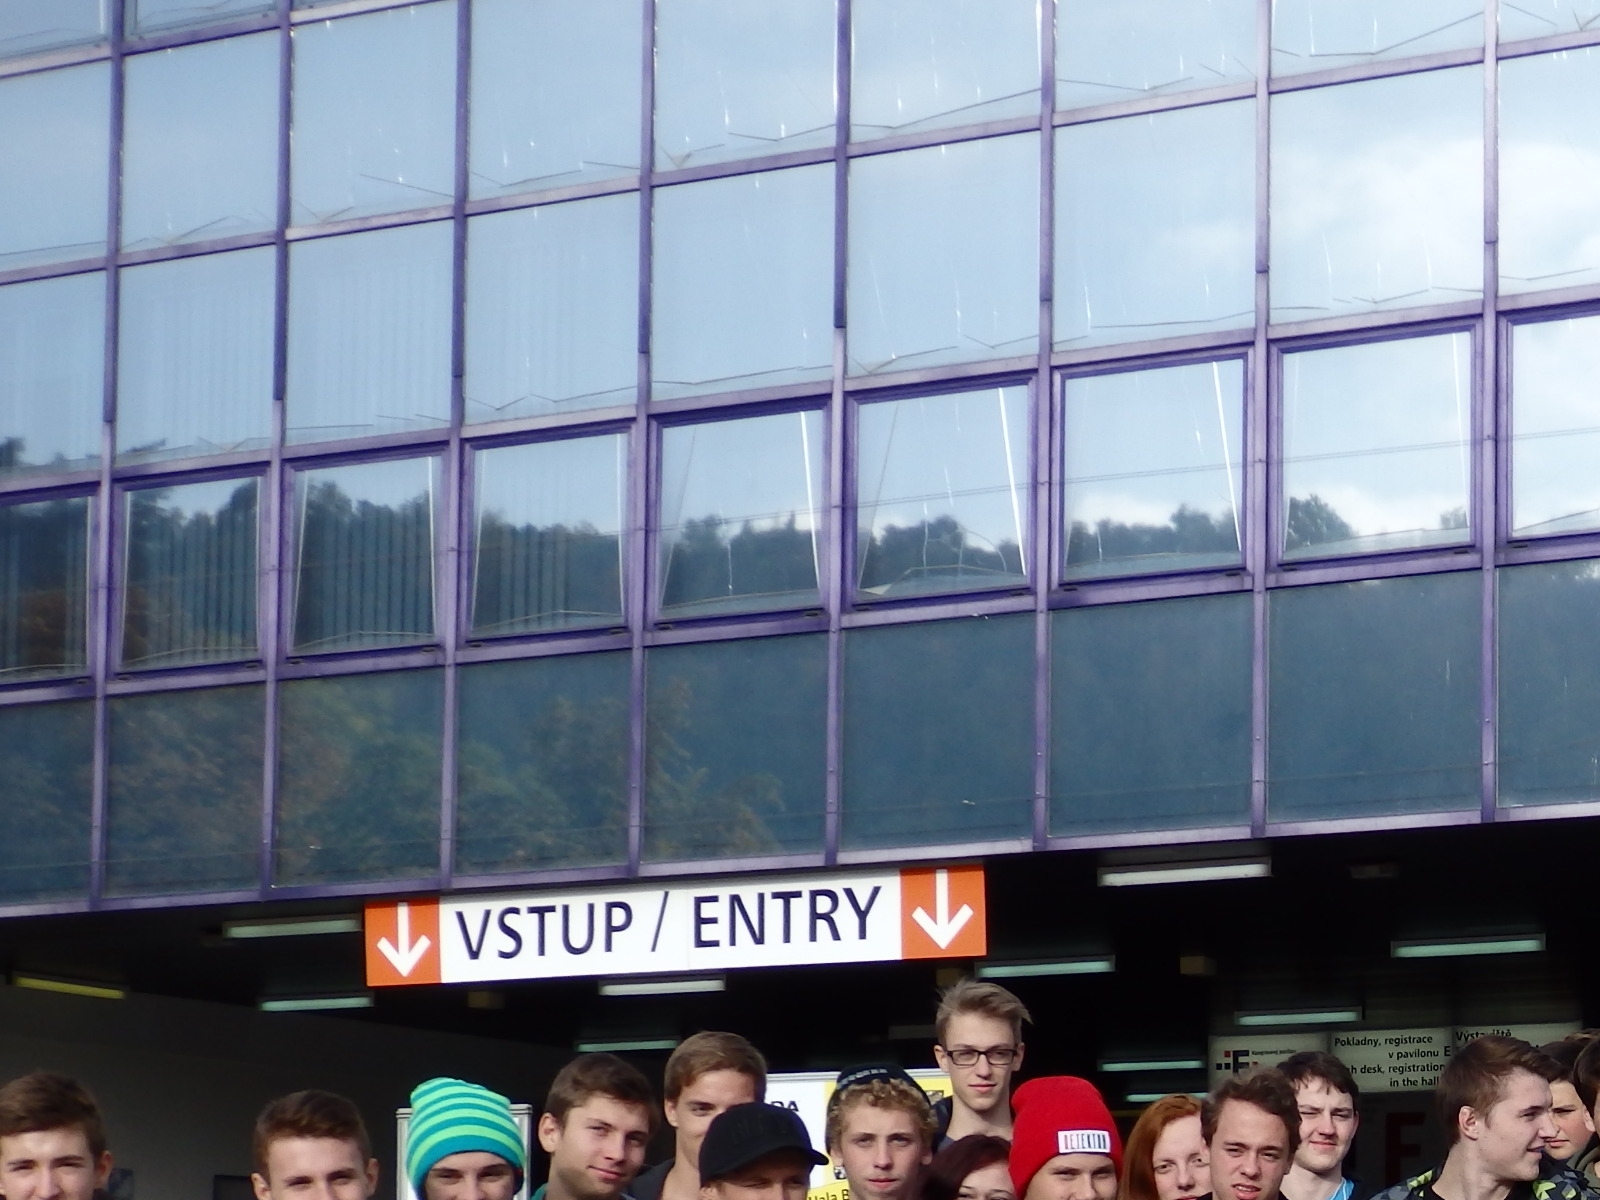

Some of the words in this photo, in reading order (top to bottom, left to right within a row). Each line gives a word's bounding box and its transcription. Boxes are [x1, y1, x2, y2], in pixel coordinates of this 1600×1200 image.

[456, 900, 633, 960] VSTUP
[694, 885, 882, 948] ENTRY
[1334, 1036, 1382, 1047] Pokladny,
[1384, 1035, 1433, 1046] registrace
[1396, 1049, 1439, 1060] pavilonu
[1443, 1046, 1451, 1057] E
[1390, 1078, 1399, 1087] in
[1402, 1078, 1418, 1087] the
